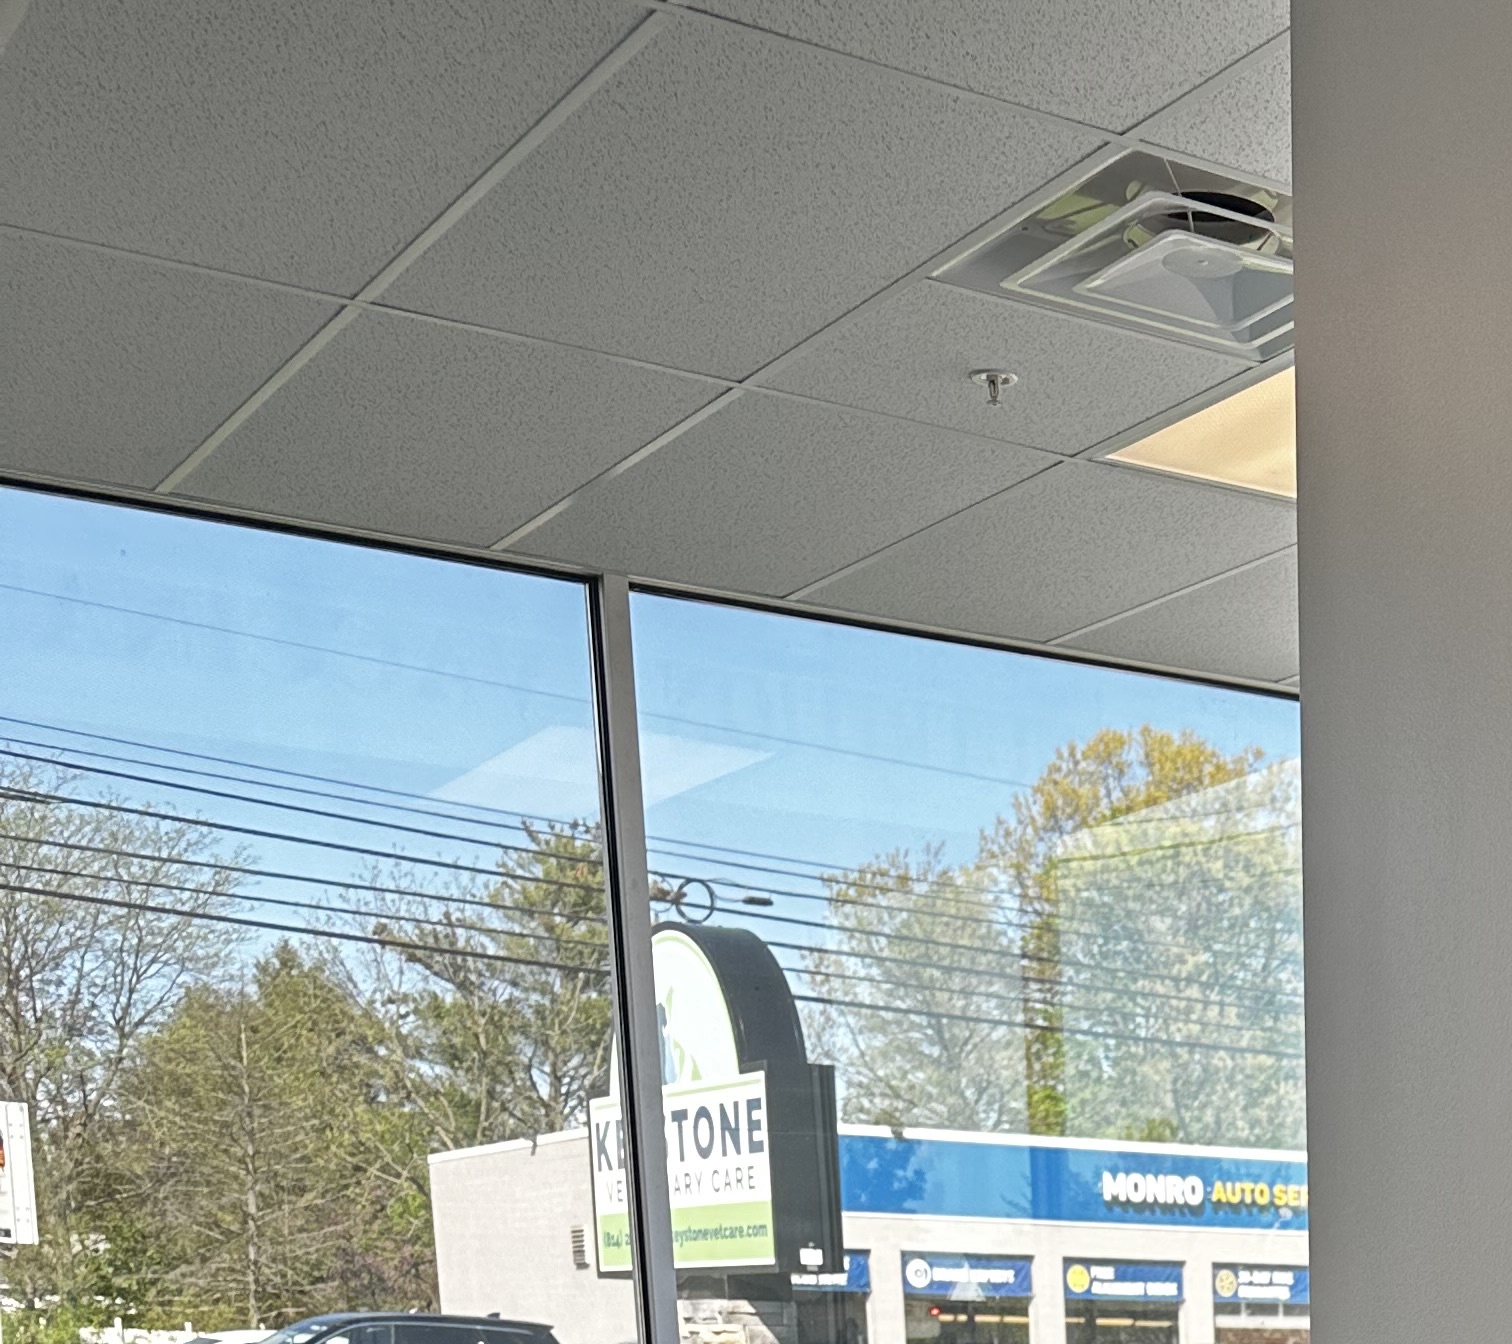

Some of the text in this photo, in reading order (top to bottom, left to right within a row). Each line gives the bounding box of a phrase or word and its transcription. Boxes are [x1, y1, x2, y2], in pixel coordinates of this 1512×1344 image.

[595, 1097, 765, 1173] KESTONE
[711, 1165, 756, 1193] CARE
[1102, 1171, 1204, 1206] MONRO
[1212, 1181, 1270, 1205] AUTO
[672, 1223, 768, 1248] eystonevetcare.com
